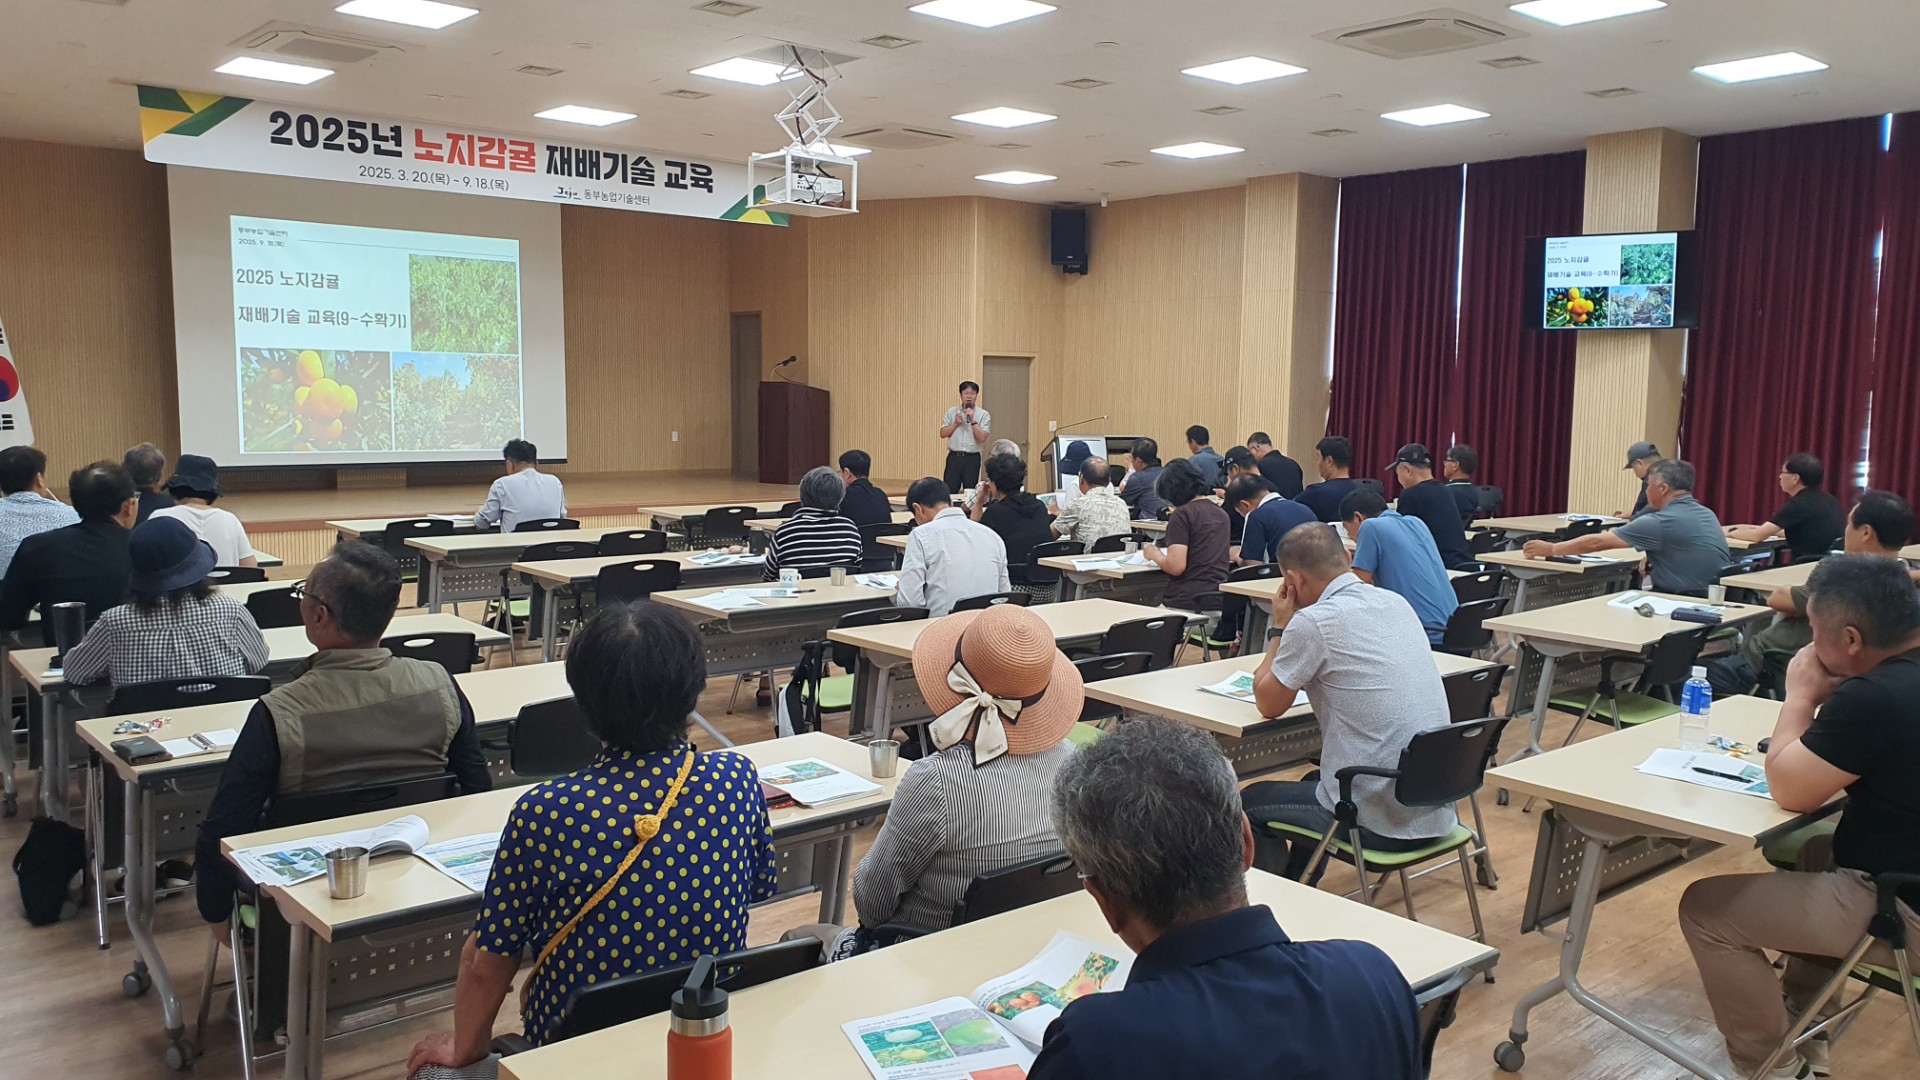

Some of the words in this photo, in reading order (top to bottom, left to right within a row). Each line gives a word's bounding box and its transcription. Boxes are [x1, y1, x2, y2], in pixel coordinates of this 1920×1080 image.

[269, 110, 403, 158] 2025년
[414, 128, 536, 174] 노지감귤
[545, 145, 655, 187] 재배기술
[664, 160, 714, 194] 교육
[359, 165, 394, 180] 2025.
[398, 169, 409, 181] 3.
[412, 171, 450, 186] 20.(목)
[462, 176, 472, 188] 9.
[475, 177, 509, 191] 18.(목)
[584, 188, 650, 206] 동부농업기술센터
[236, 268, 274, 286] 2025
[280, 271, 340, 290] 노지감귤
[238, 306, 301, 325] 재배기술
